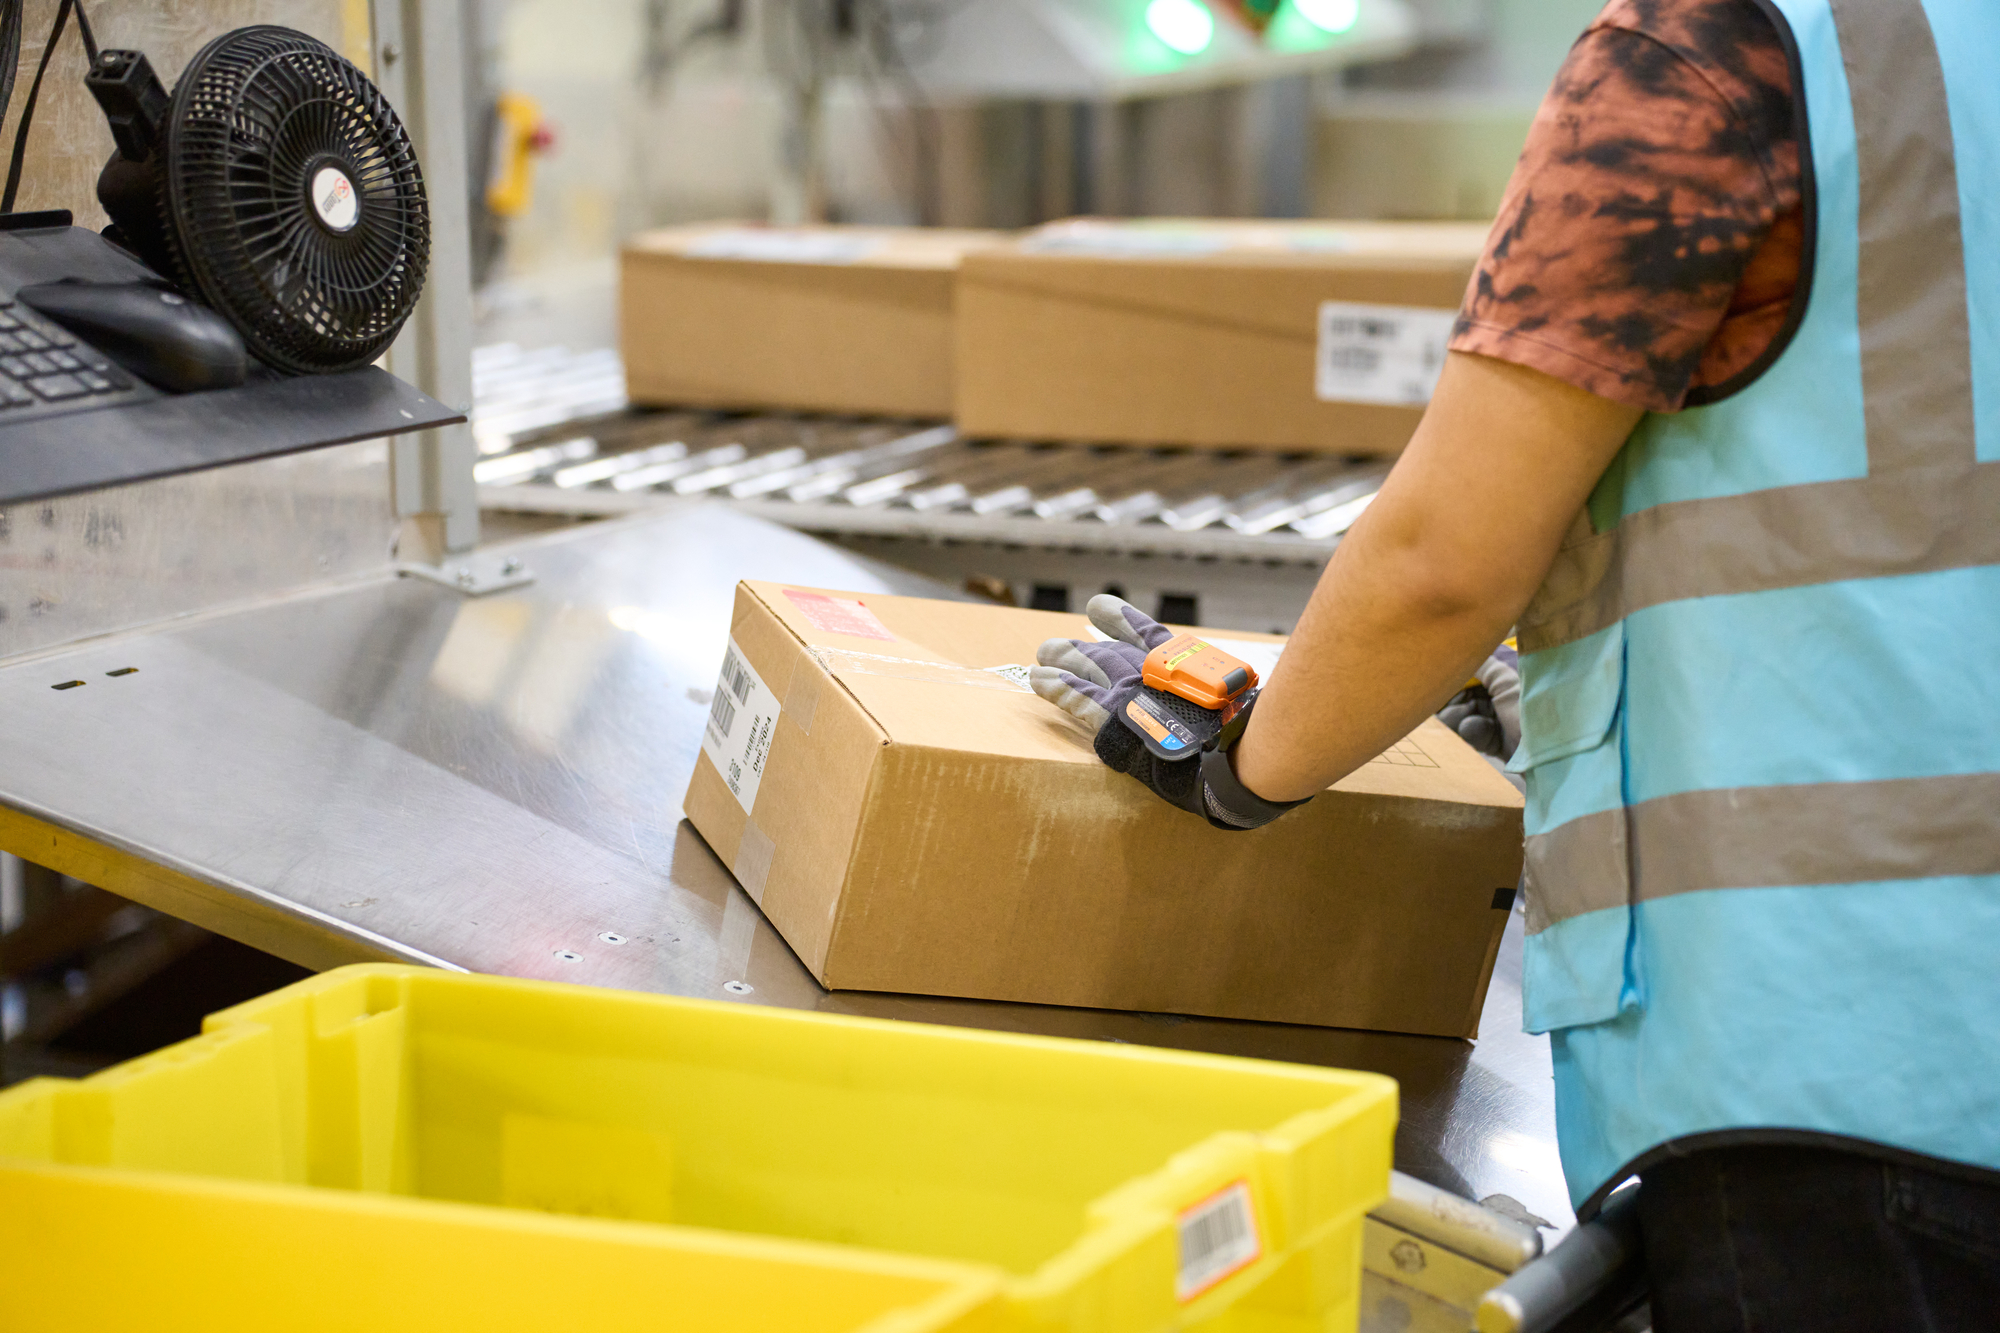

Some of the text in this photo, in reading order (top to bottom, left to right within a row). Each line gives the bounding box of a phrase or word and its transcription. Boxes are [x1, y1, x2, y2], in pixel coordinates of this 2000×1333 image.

[1136, 708, 1158, 728] PROGLOVE
[752, 716, 772, 772] Dec 2024
[729, 758, 742, 781] 3109
